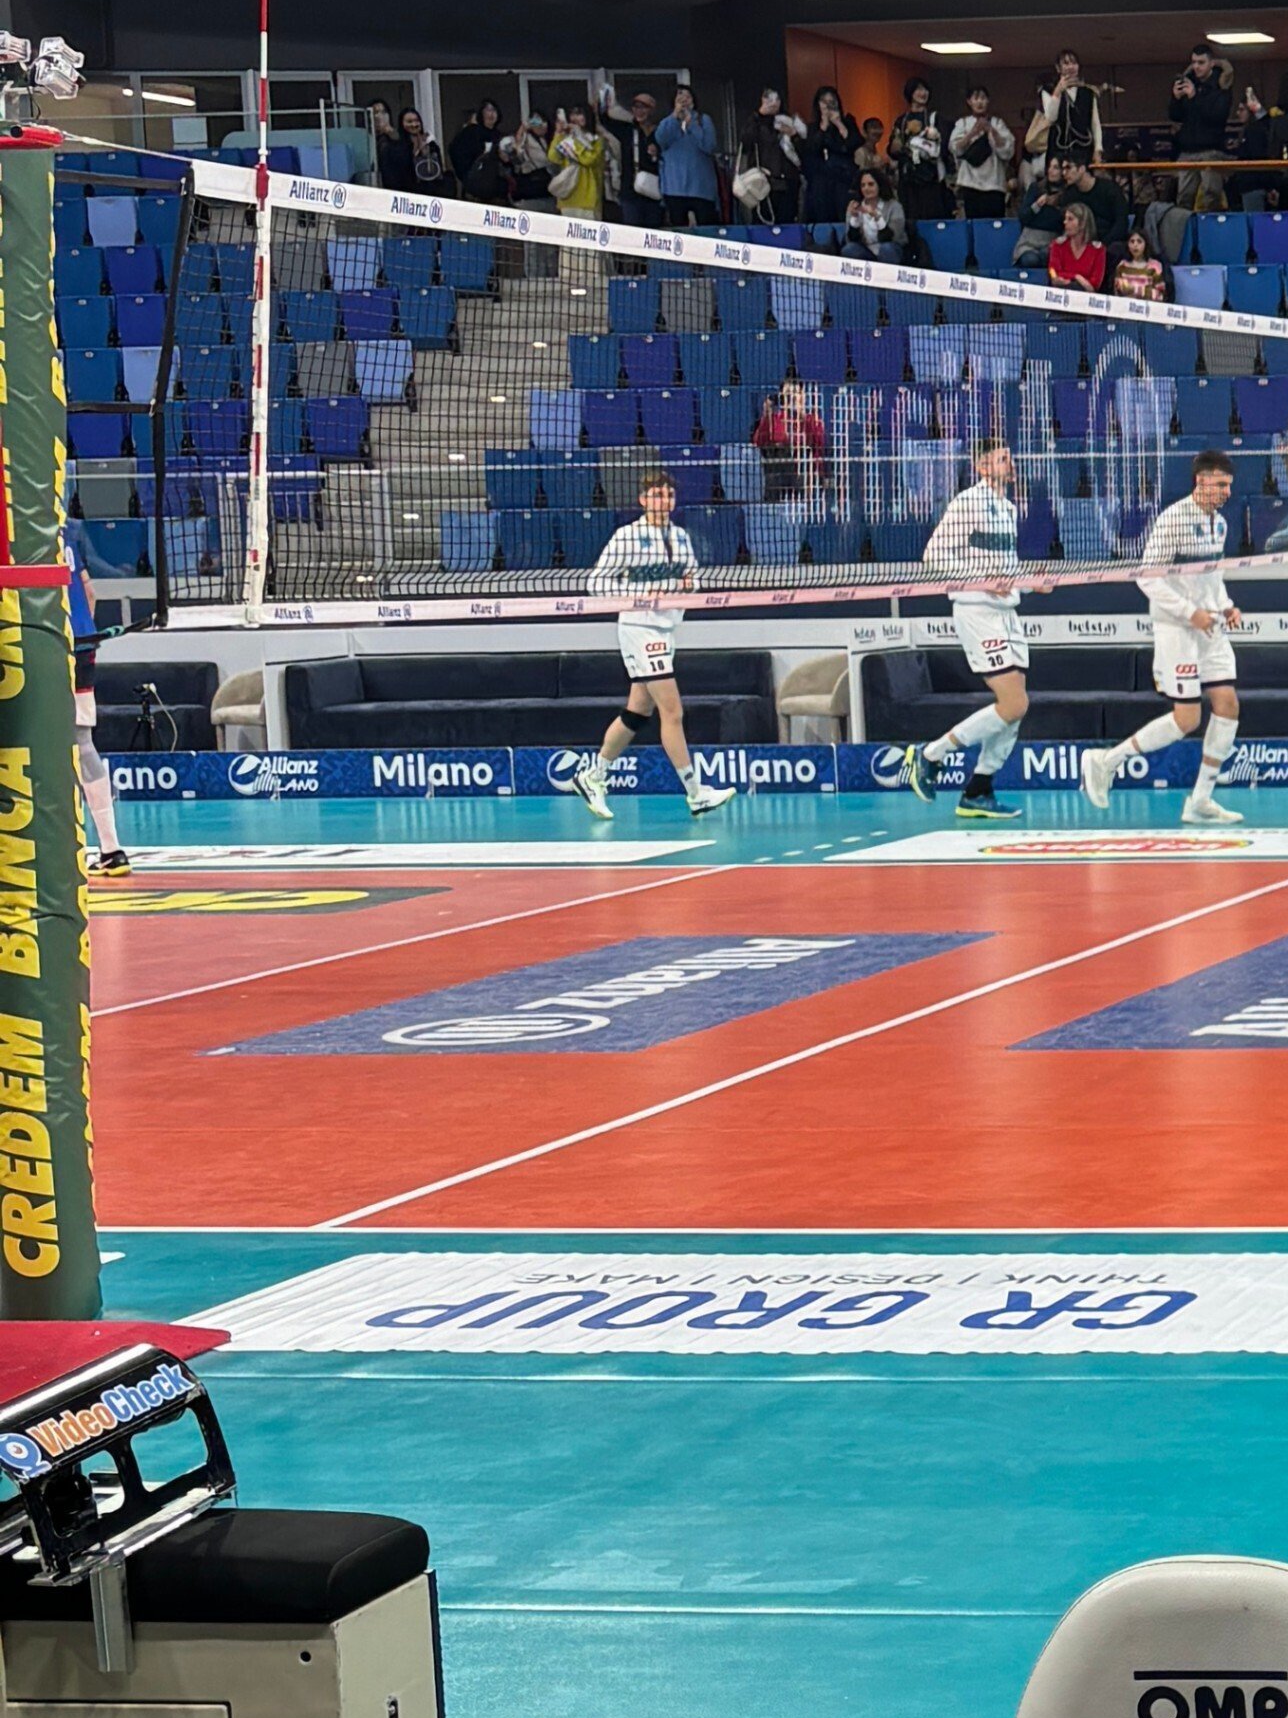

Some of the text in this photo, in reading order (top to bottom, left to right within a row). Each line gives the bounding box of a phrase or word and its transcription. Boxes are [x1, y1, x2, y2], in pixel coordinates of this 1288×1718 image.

[289, 180, 329, 204] Allianz
[391, 196, 427, 218] Allianz
[483, 209, 517, 230] Allianz
[566, 222, 597, 241] Allianz
[643, 233, 672, 253] Allianz
[714, 243, 741, 262] Allianz
[780, 252, 804, 270] Allianz
[840, 261, 864, 279] Allianz
[256, 756, 318, 775] Allianz
[372, 753, 493, 788] Milano
[694, 751, 816, 785] Milano
[0, 745, 42, 979] BANCA
[514, 937, 856, 1012] Allianz
[0, 1016, 62, 1279] CREDEM
[513, 1273, 679, 1287] MAKE
[736, 1272, 943, 1287] DESIGN
[1002, 1272, 1169, 1287] THINK
[365, 1288, 1199, 1332] GR GROUP
[26, 1363, 196, 1458] VideoCheck
